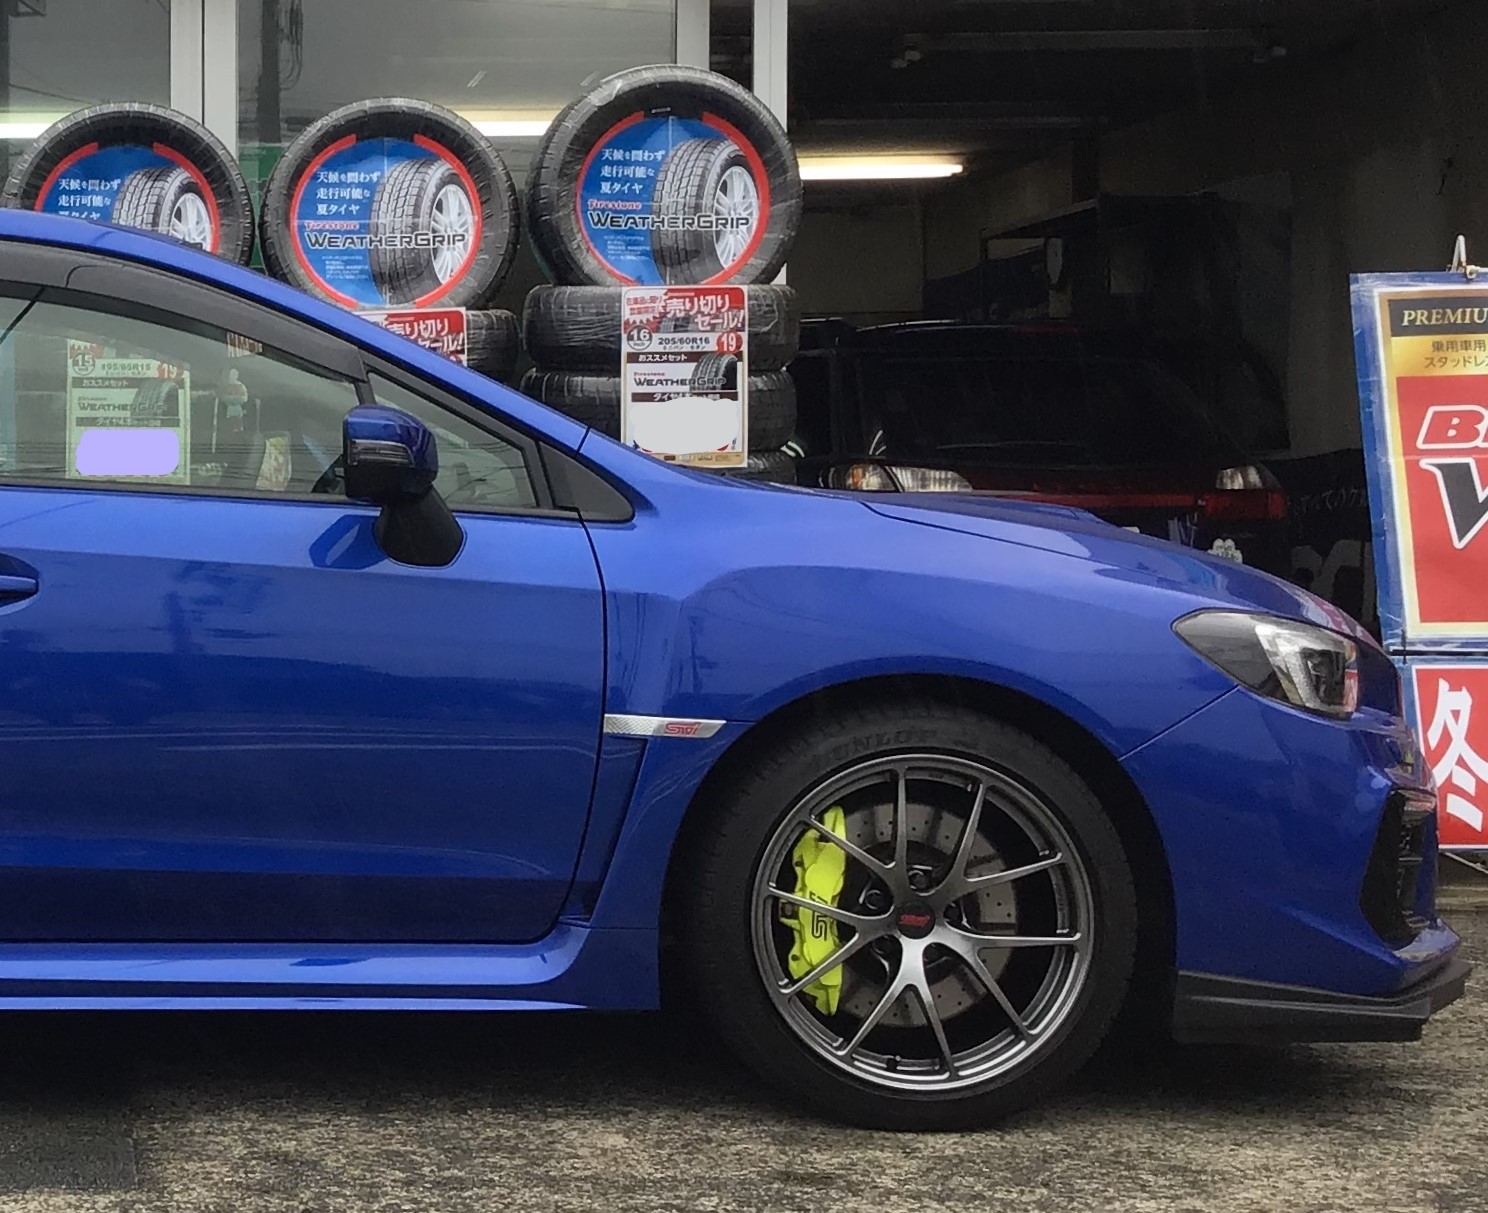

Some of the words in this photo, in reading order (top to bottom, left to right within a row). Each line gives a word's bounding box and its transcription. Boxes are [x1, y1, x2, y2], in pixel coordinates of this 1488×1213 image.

[601, 149, 665, 162] 天候を問わず
[317, 171, 381, 184] 天候を問わず
[600, 165, 655, 178] 走行可能な
[58, 178, 121, 191] 天候を問わず
[600, 181, 644, 194] 夏タイヤ
[316, 187, 371, 200] 走行可能な
[58, 194, 112, 207] 走行可能な
[316, 203, 360, 215] 夏タイヤ
[666, 294, 730, 318] 売り切り
[630, 328, 650, 341] 16
[658, 336, 711, 346] 205/60R16
[720, 332, 737, 352] 19
[1431, 339, 1487, 353] 乗用車用
[76, 354, 93, 367] 15
[638, 354, 688, 362] おススメセット
[1426, 677, 1488, 833] 冬
